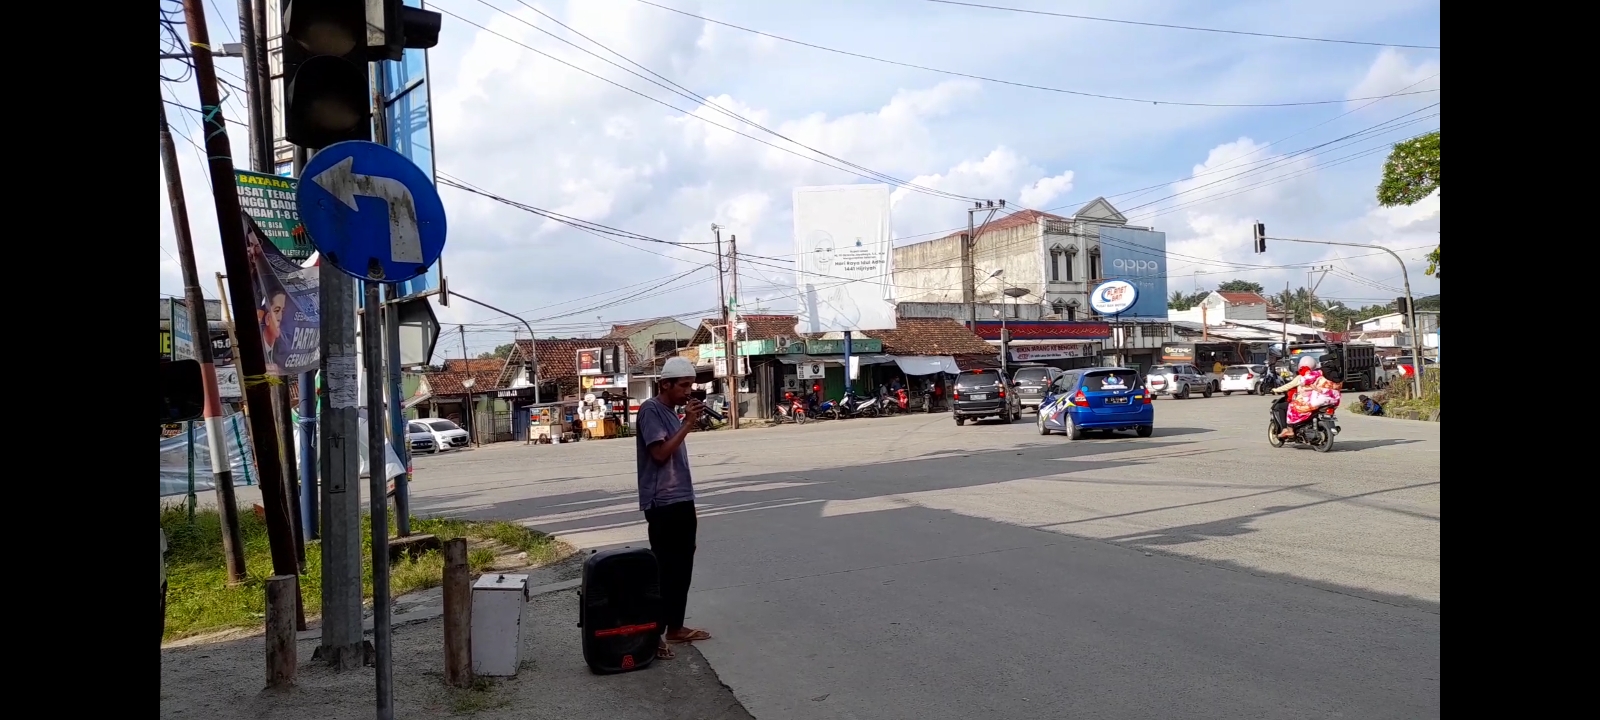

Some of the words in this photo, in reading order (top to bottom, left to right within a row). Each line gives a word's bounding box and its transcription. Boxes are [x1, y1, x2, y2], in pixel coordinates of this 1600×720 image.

[240, 174, 289, 189] BATARA
[236, 185, 264, 197] USAT
[238, 196, 268, 208] INGGI
[270, 199, 297, 211] BADA
[241, 207, 274, 218] MBAH
[275, 210, 291, 220] 1-8
[268, 221, 283, 229] BISA
[262, 229, 290, 238] ASILNYA
[1113, 258, 1158, 272] oppo
[212, 337, 231, 349] 15.0
